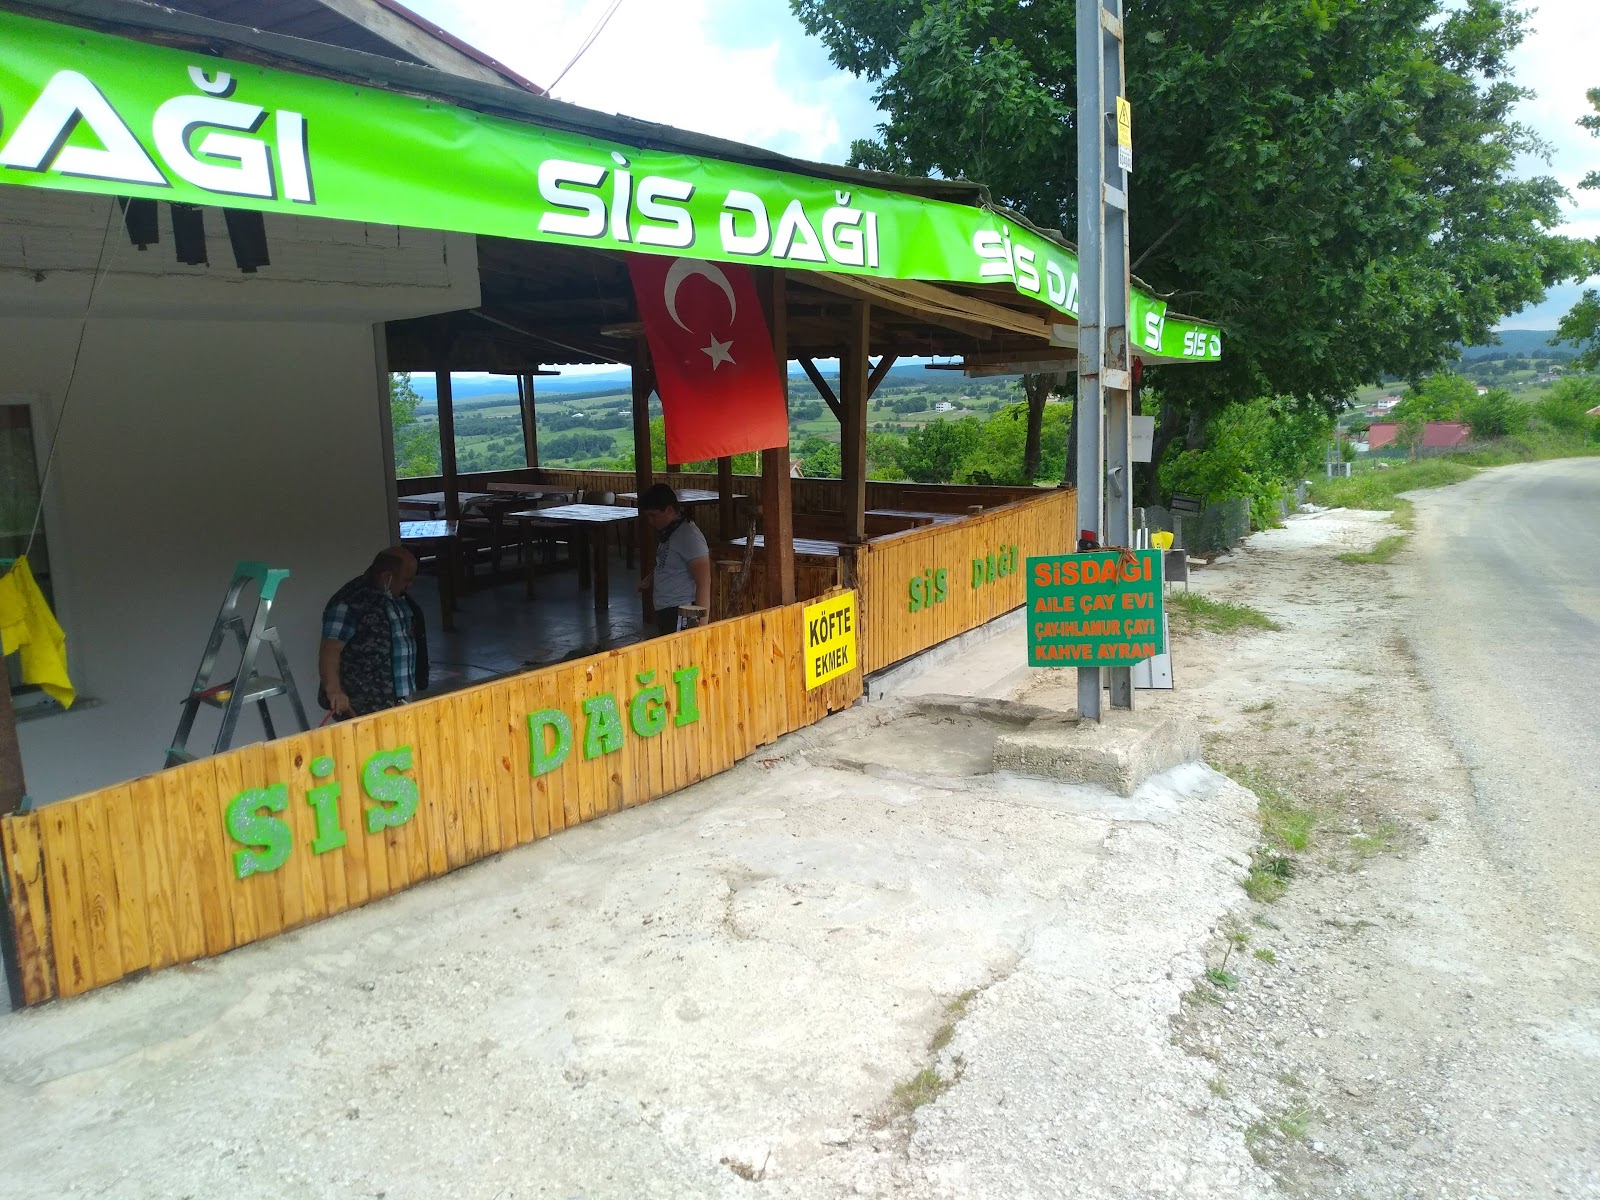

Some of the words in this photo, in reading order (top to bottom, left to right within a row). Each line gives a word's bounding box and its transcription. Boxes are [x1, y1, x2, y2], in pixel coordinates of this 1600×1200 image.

[0, 65, 316, 204] AĞI
[537, 151, 696, 249] SİS
[719, 190, 879, 268] DAĞI
[973, 224, 1041, 294] SİS
[1183, 326, 1208, 357] SİS
[909, 567, 948, 613] SİS
[971, 544, 1019, 589] DAĞI
[1035, 596, 1075, 613] AİLE
[1080, 594, 1116, 614] ÇAY
[1122, 592, 1154, 609] EVİ
[809, 606, 852, 648] KÖFTE
[1034, 620, 1121, 641] ÇAY-IHLAMUR
[1124, 618, 1155, 639] ÇAYI
[815, 644, 849, 678] EKMEK
[1035, 644, 1092, 660] KAHVE
[1097, 642, 1155, 659] AYRAN
[226, 745, 420, 879] SİS
[527, 666, 700, 777] DAĞI
